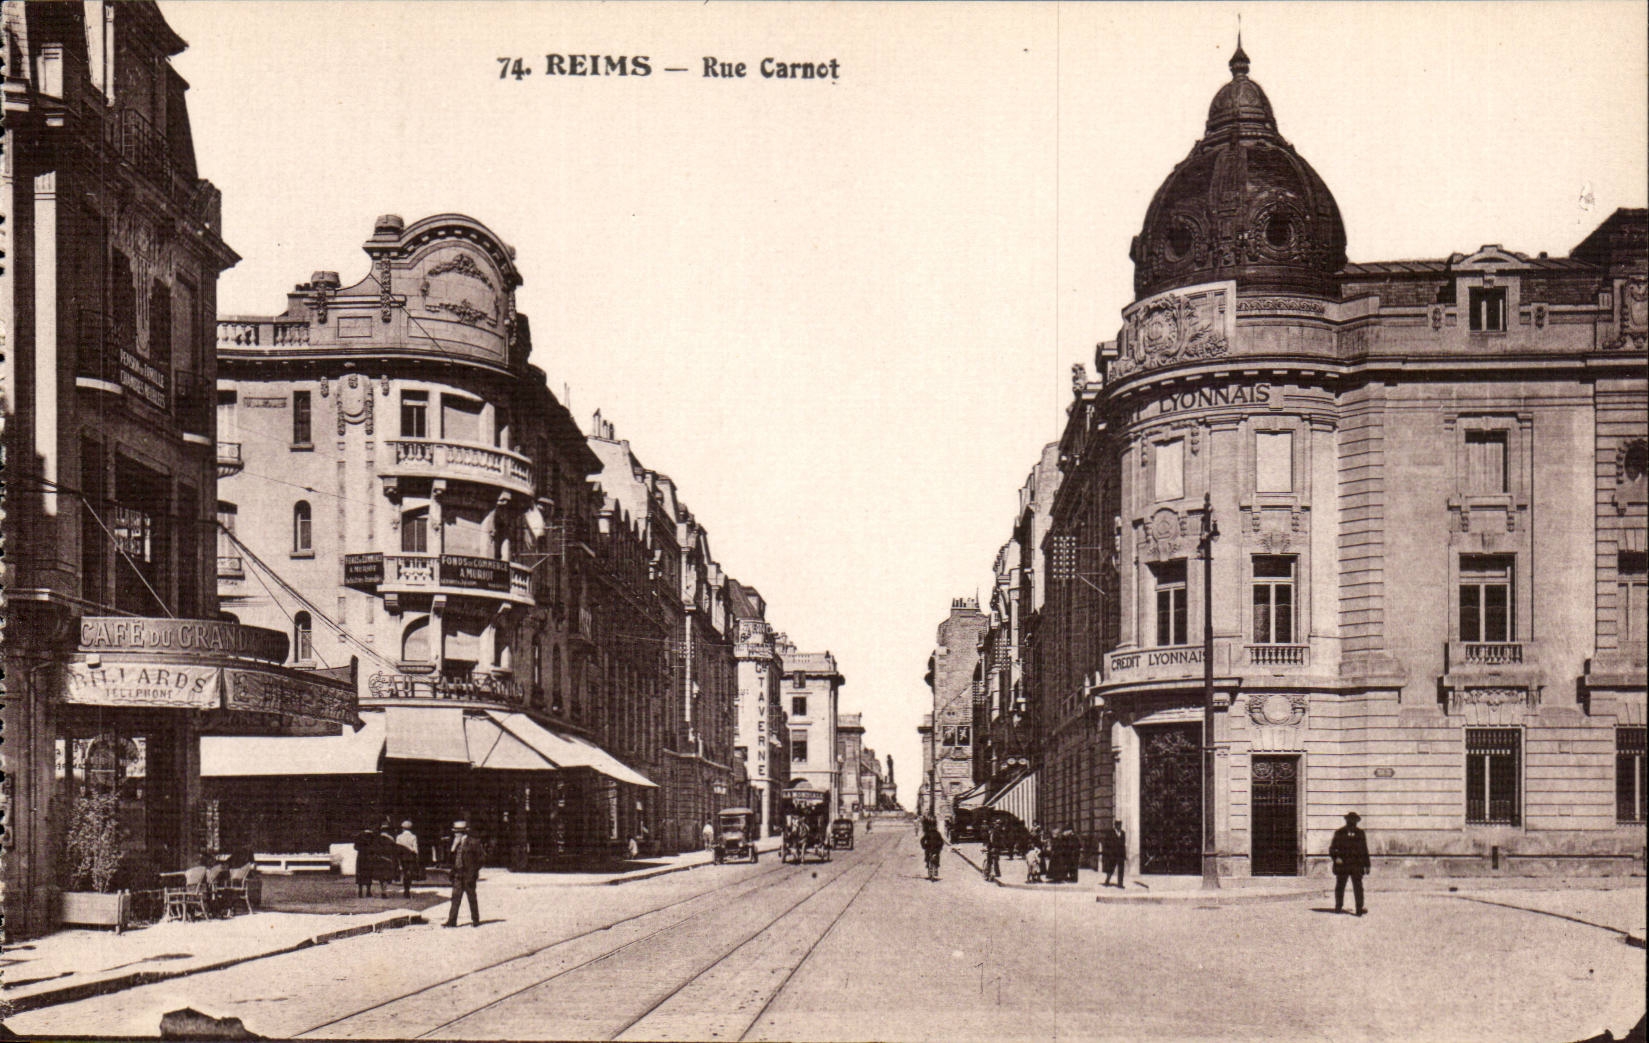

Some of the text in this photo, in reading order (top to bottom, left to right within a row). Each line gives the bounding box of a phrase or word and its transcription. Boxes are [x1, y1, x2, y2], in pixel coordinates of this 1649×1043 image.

[1158, 383, 1272, 413] LYONNAIS
[441, 555, 468, 567] FONDS
[473, 558, 509, 572] COMMERCE
[80, 620, 145, 648] CAFÉ
[150, 630, 172, 648] DU
[757, 676, 767, 777] TAVERNE
